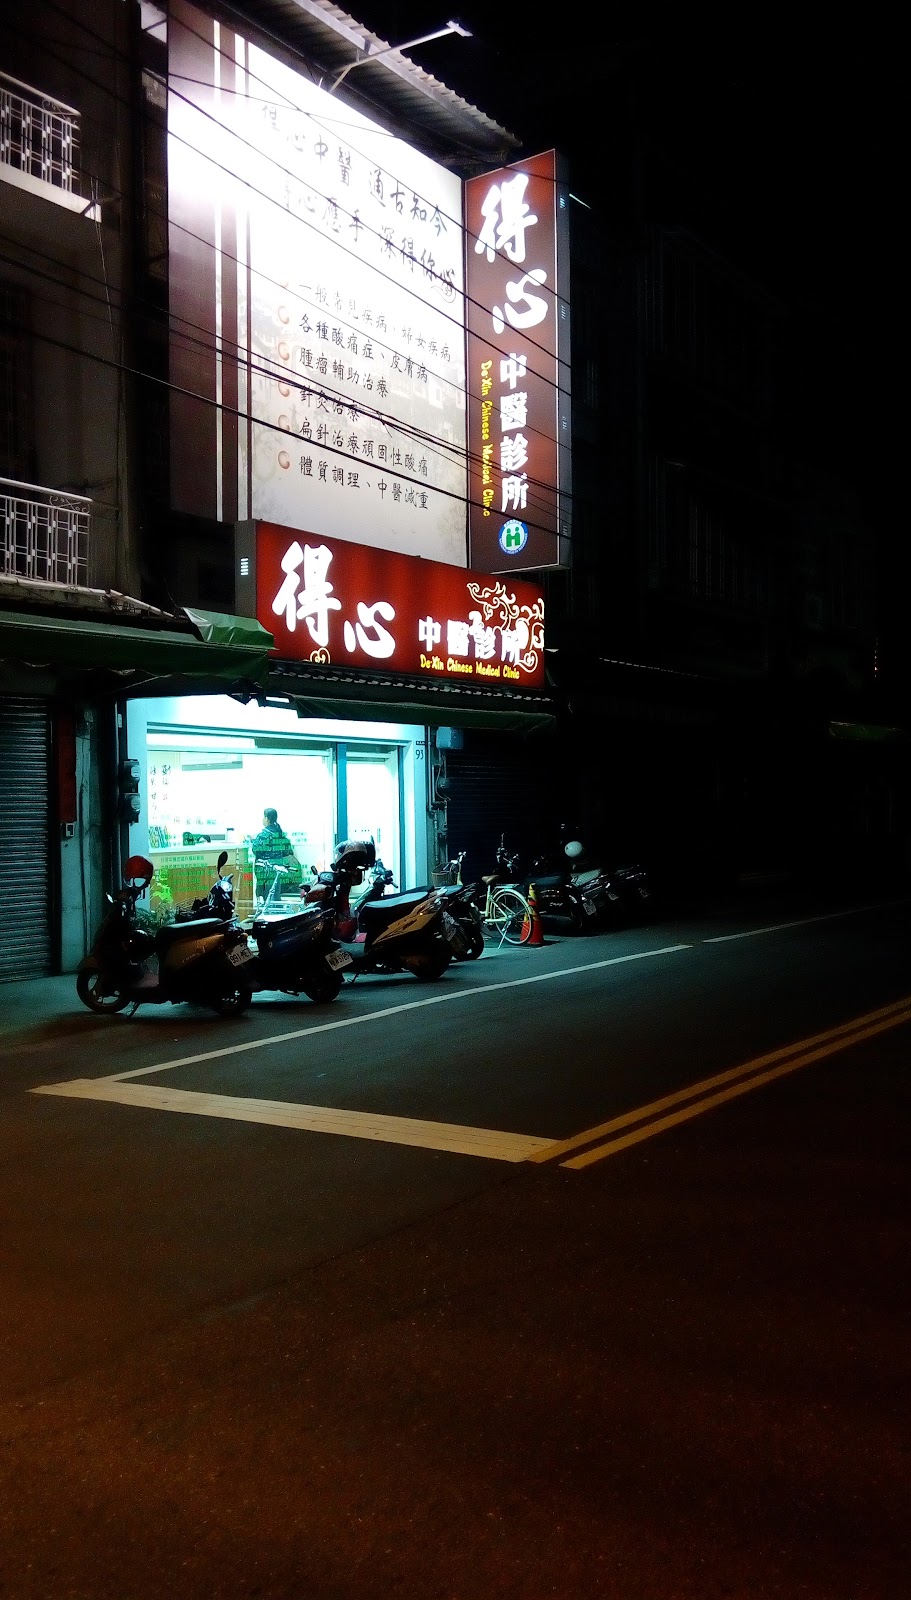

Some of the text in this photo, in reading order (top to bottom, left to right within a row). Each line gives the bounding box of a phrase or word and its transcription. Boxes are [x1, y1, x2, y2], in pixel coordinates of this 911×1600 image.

[369, 168, 448, 236] 通古知今
[299, 313, 428, 383] 各種酸痛症、皮膚病
[299, 347, 388, 398] 腫瘤輔助治療
[299, 417, 428, 477] 扁針治療頑固性酸痛
[482, 400, 493, 440] Chinese
[499, 352, 528, 512] 中醫診所
[299, 456, 429, 509] 體質調理、中醫減重
[272, 540, 528, 666] 得心 中醫診所
[446, 658, 473, 675] Chinese
[476, 661, 501, 678] Medical
[502, 664, 520, 680] Clinic
